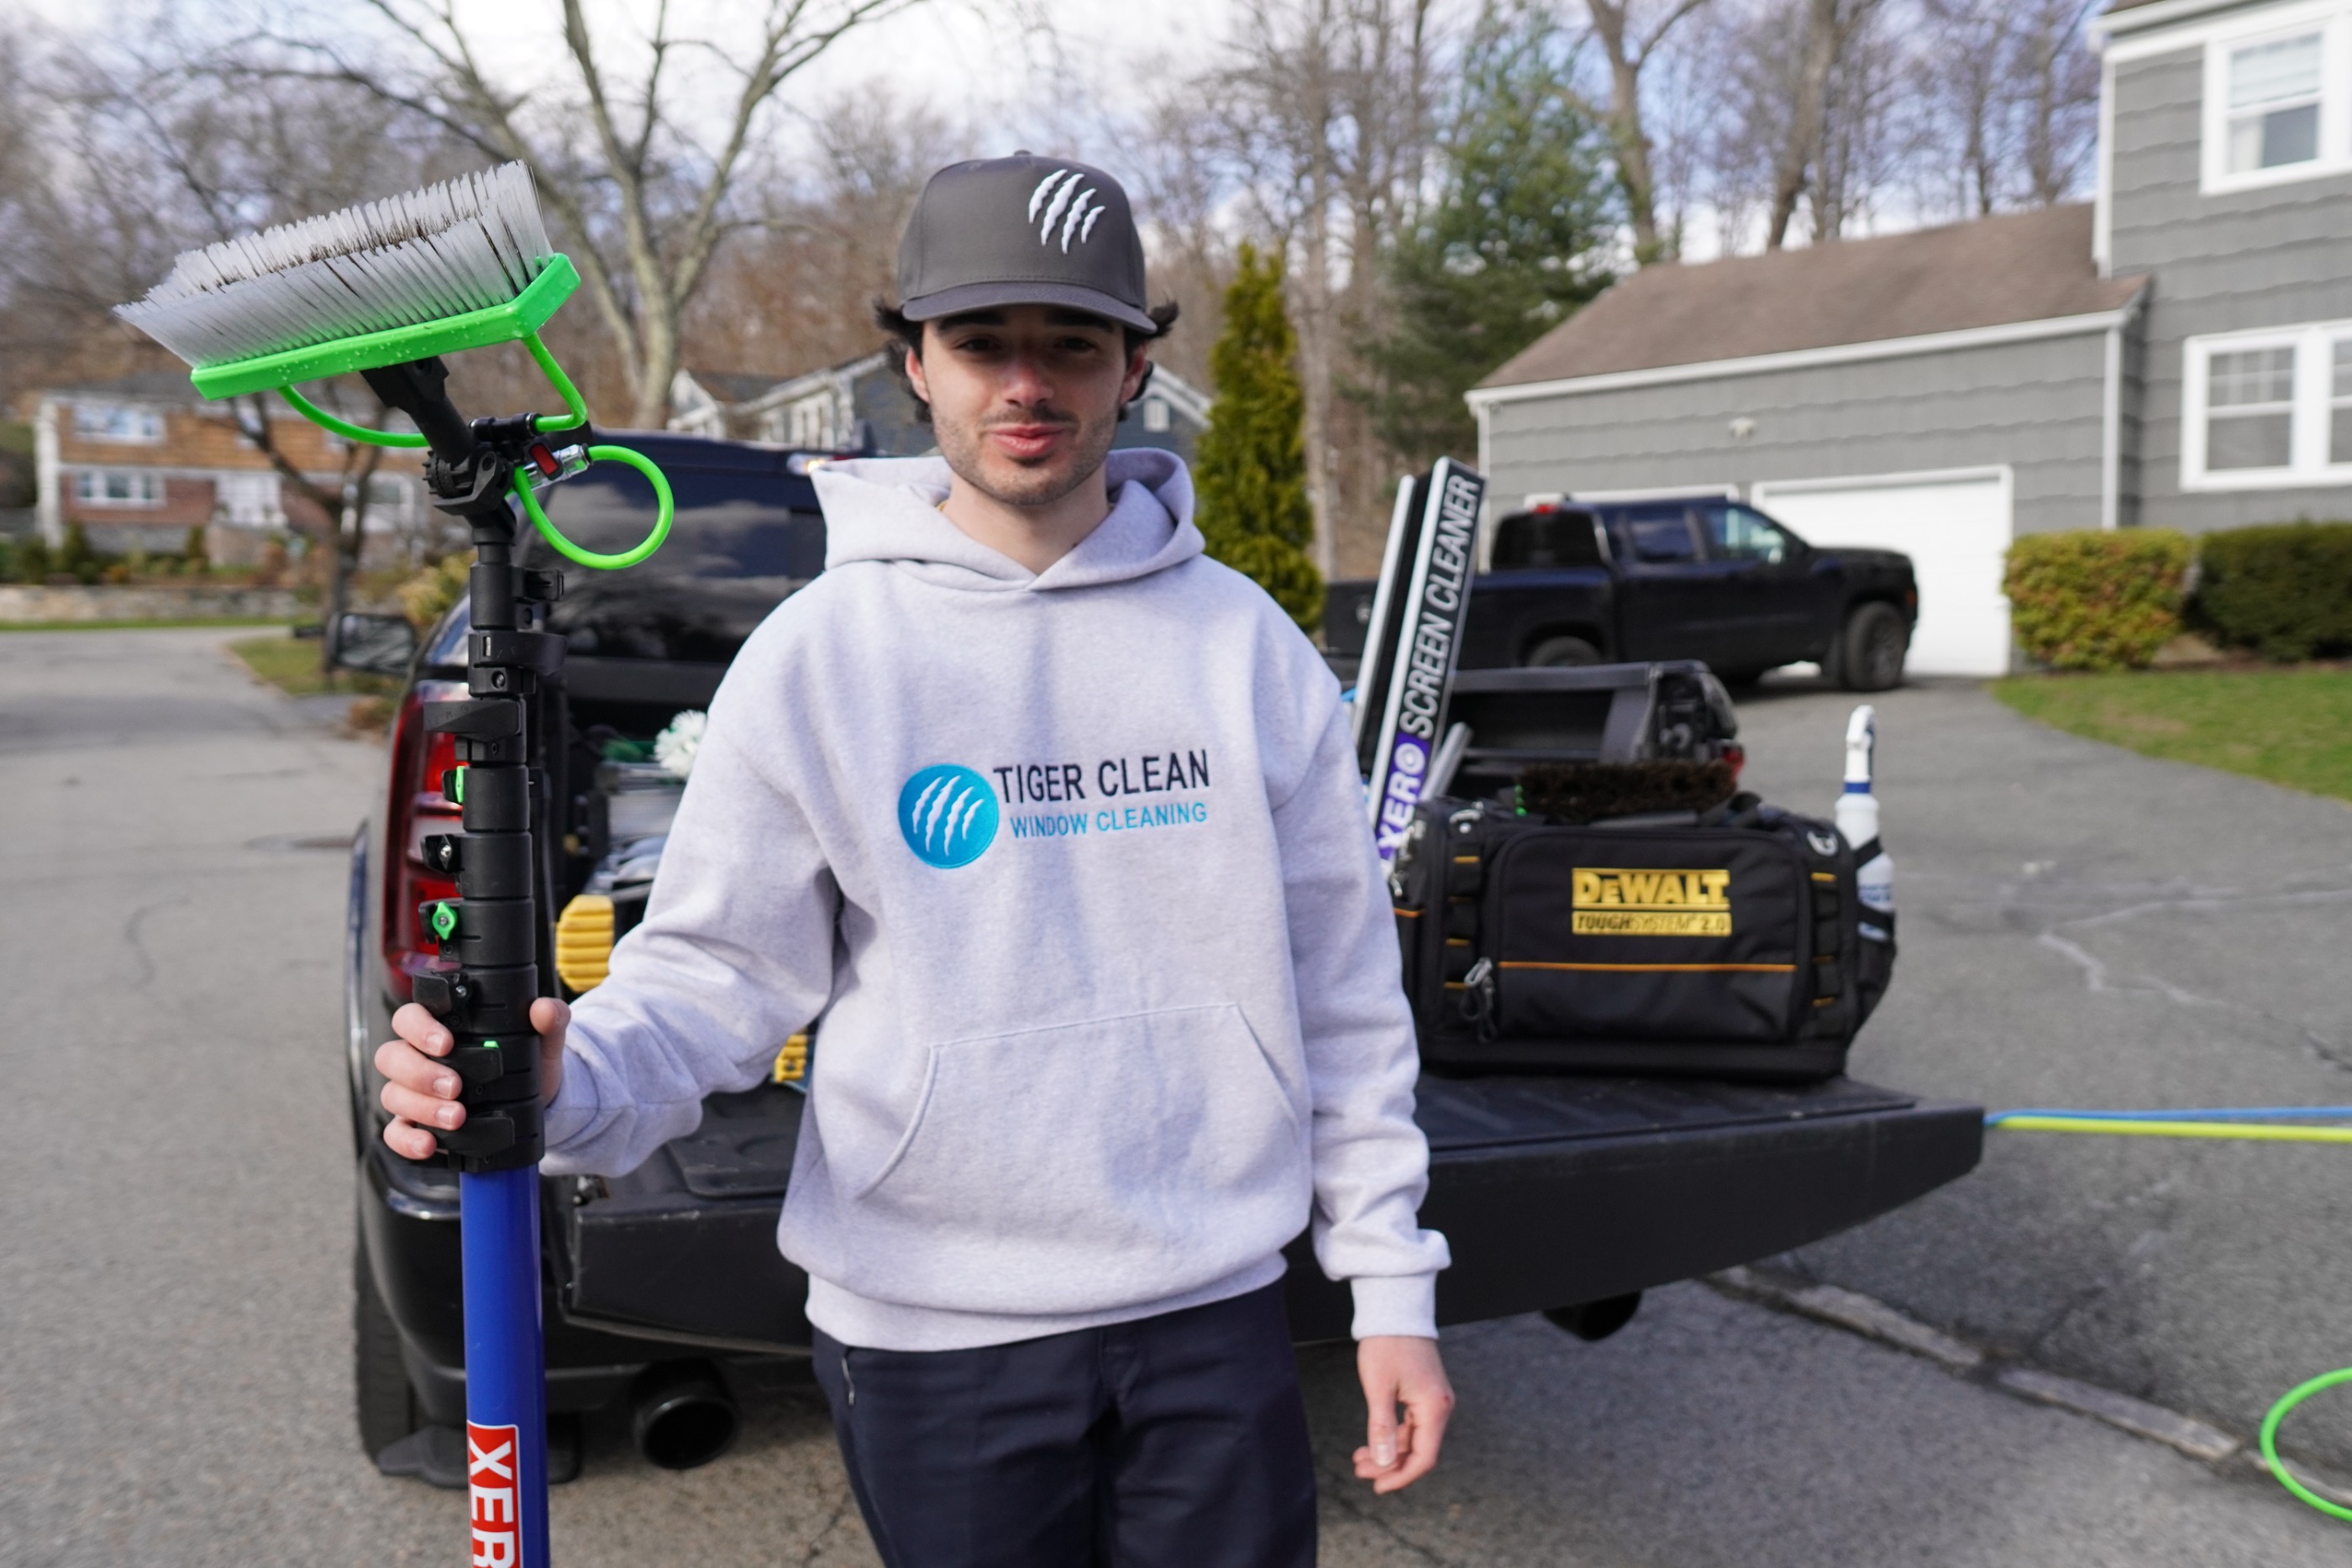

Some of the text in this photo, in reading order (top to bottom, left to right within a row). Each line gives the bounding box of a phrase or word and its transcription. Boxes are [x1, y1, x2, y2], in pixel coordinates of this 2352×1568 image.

[1425, 473, 1481, 611] CLEANER
[1399, 613, 1452, 740] SCREEN
[993, 748, 1210, 804] TIGER CLEAN
[1010, 801, 1208, 839] WINDOW CLEANING
[1572, 871, 1730, 905] DEWALT
